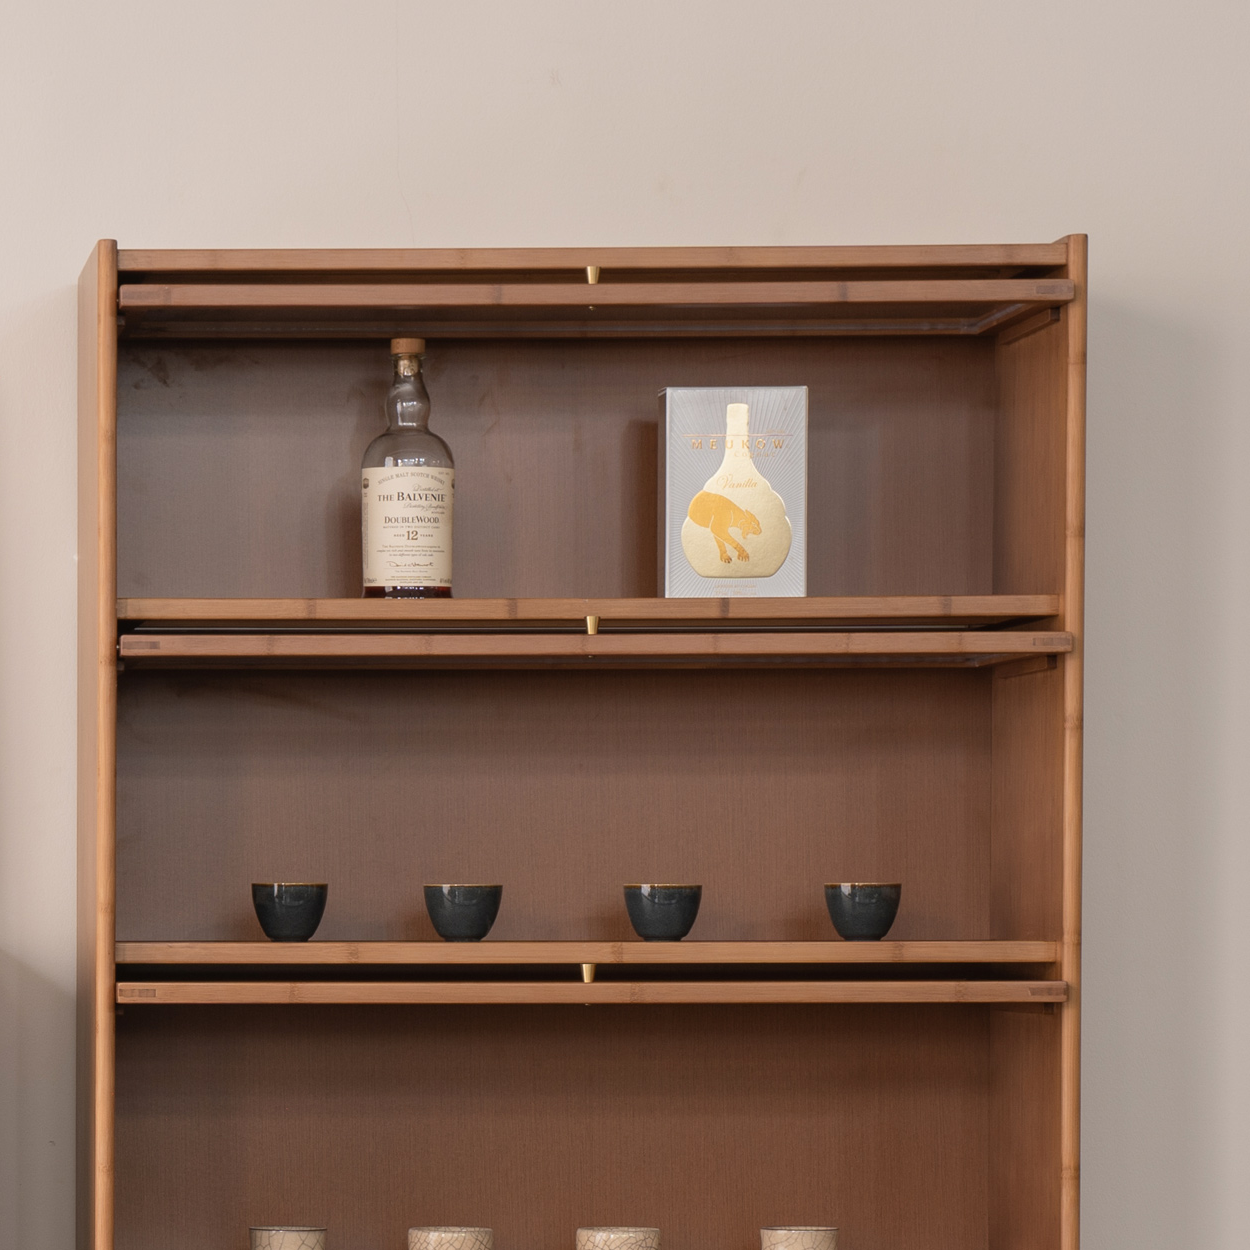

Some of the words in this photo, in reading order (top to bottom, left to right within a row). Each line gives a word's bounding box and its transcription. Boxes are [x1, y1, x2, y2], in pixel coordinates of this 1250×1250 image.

[691, 438, 785, 450] MEUKOW
[717, 473, 758, 490] Vanilla
[378, 494, 395, 502] THE
[397, 491, 447, 502] BALVENIE
[406, 530, 419, 541] 12
